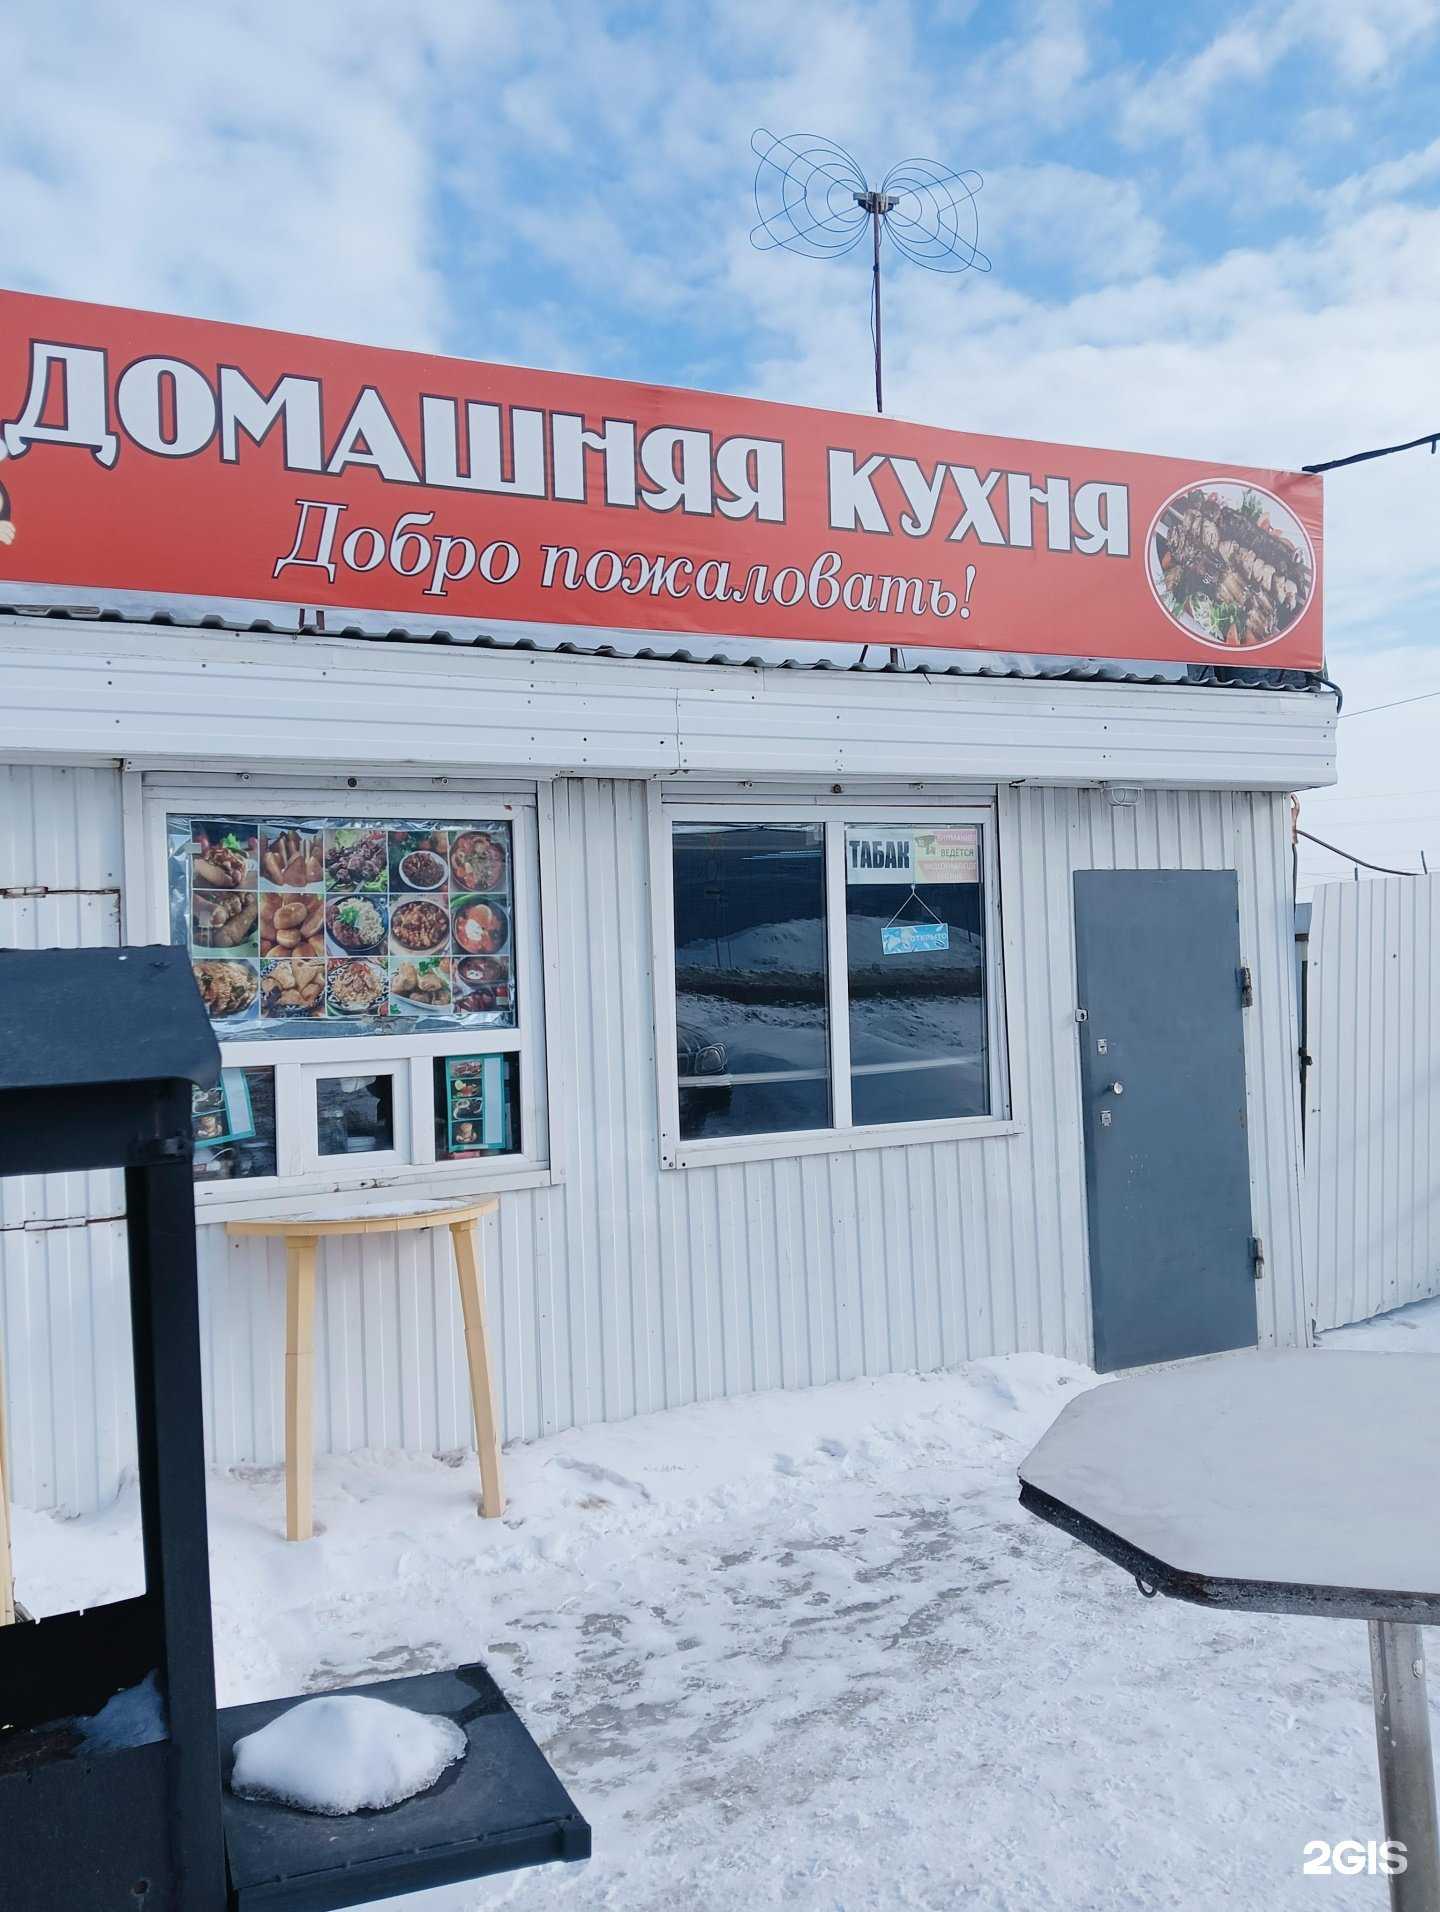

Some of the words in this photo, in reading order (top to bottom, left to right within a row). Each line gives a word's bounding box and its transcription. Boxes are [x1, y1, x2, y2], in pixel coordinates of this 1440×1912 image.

[2, 337, 788, 525] ДОМАШНЯЯ
[825, 446, 1131, 557] КУХНЯ
[273, 498, 521, 597] Добро
[540, 543, 977, 620] пожаловать!
[848, 840, 910, 869] ТАБАК
